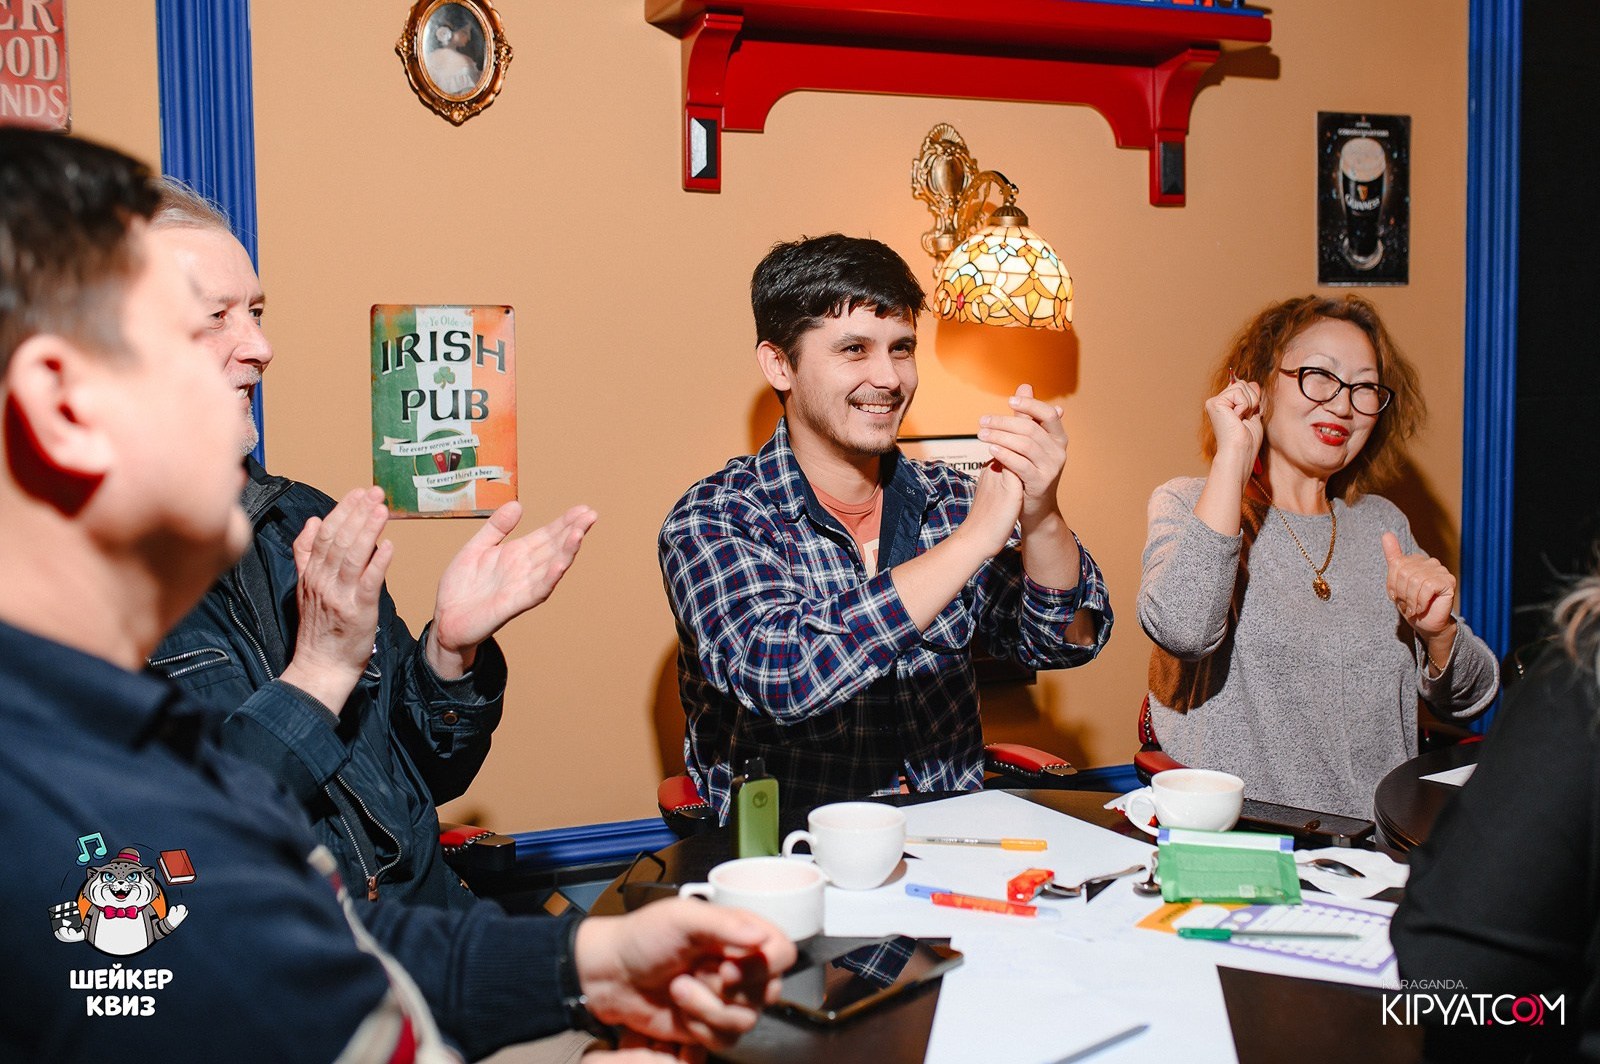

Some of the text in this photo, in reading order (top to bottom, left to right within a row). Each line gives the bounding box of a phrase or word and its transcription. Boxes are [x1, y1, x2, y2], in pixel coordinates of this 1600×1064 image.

[0, 35, 59, 82] OD
[381, 330, 506, 375] IRISH
[401, 388, 489, 423] PUB
[399, 445, 410, 453] For
[410, 445, 428, 453] every
[457, 437, 473, 445] cheer
[426, 477, 435, 485] for
[436, 474, 454, 483] every
[479, 468, 493, 476] beer
